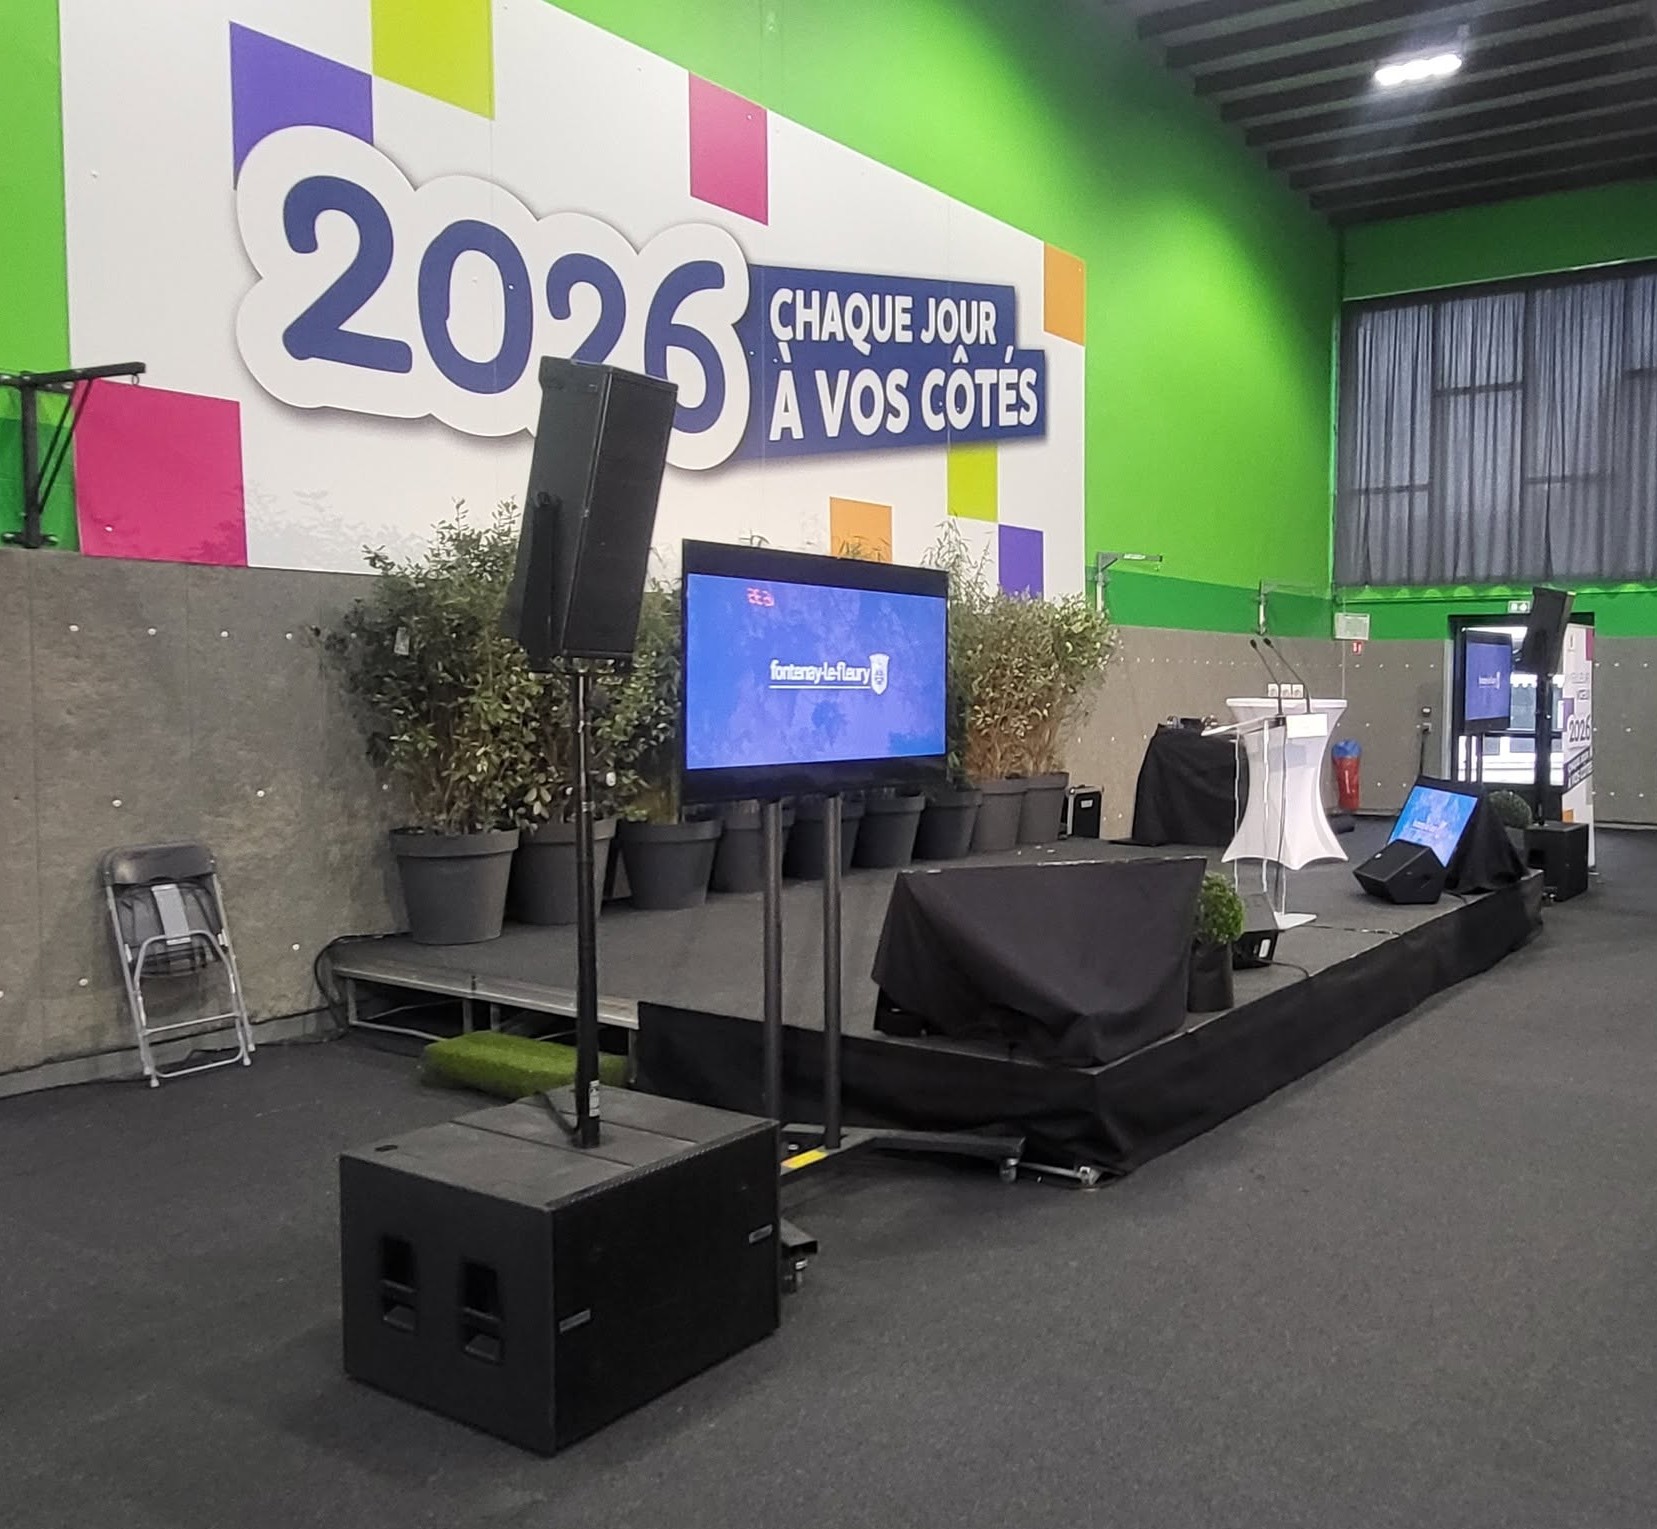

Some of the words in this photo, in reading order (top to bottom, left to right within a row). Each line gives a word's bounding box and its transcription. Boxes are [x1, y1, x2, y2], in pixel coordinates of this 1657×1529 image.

[282, 175, 725, 433] 2026
[769, 287, 913, 356] CHAQUE
[920, 297, 997, 345] JOUR
[768, 341, 804, 441] À
[815, 368, 910, 437] VOS
[921, 344, 1038, 431] CÔTÉS
[1568, 714, 1591, 743] 2026
